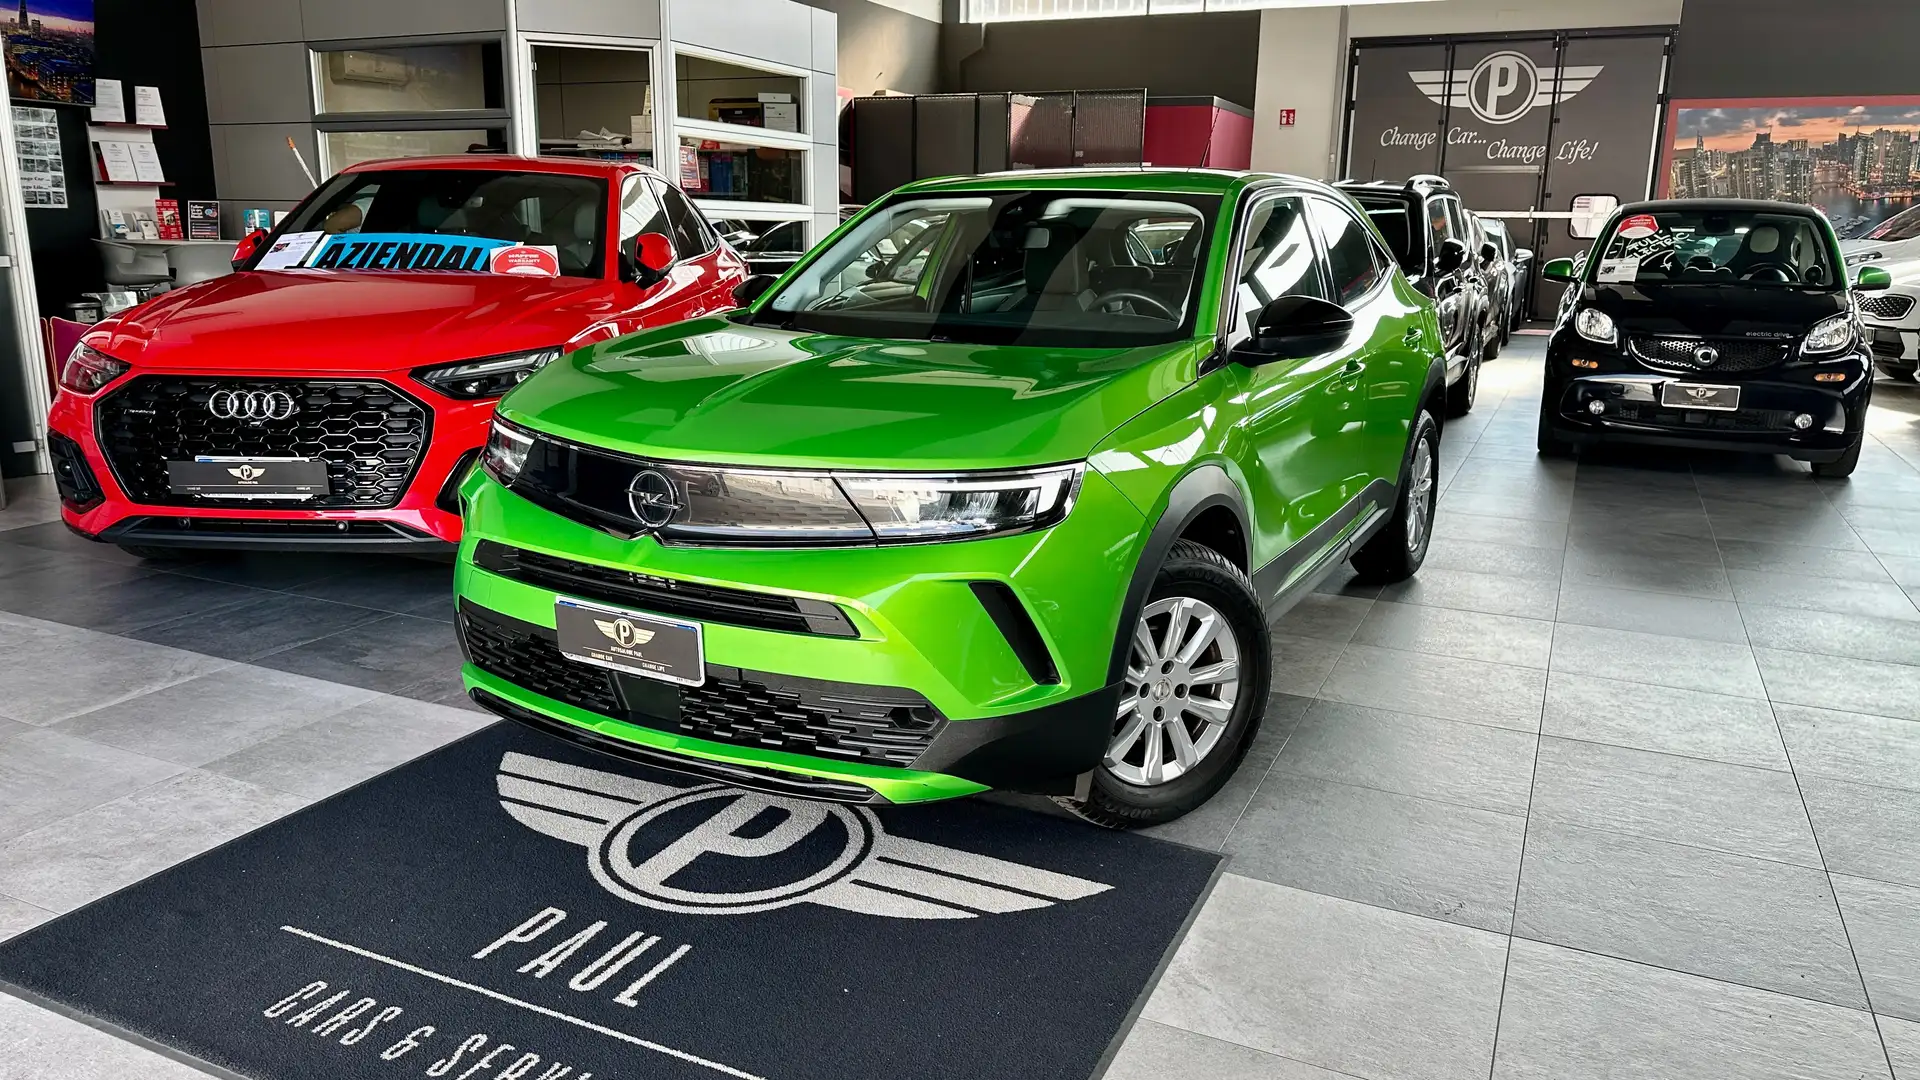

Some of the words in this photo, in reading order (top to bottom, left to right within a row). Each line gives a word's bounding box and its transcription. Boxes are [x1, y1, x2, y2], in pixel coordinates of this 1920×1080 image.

[1486, 60, 1519, 116] P
[1380, 127, 1436, 151] Change
[1447, 127, 1487, 146] Car...
[1486, 140, 1546, 163] Change
[1554, 140, 1599, 165] Life!
[472, 905, 693, 1008] PAUL
[263, 980, 404, 1046] CARS
